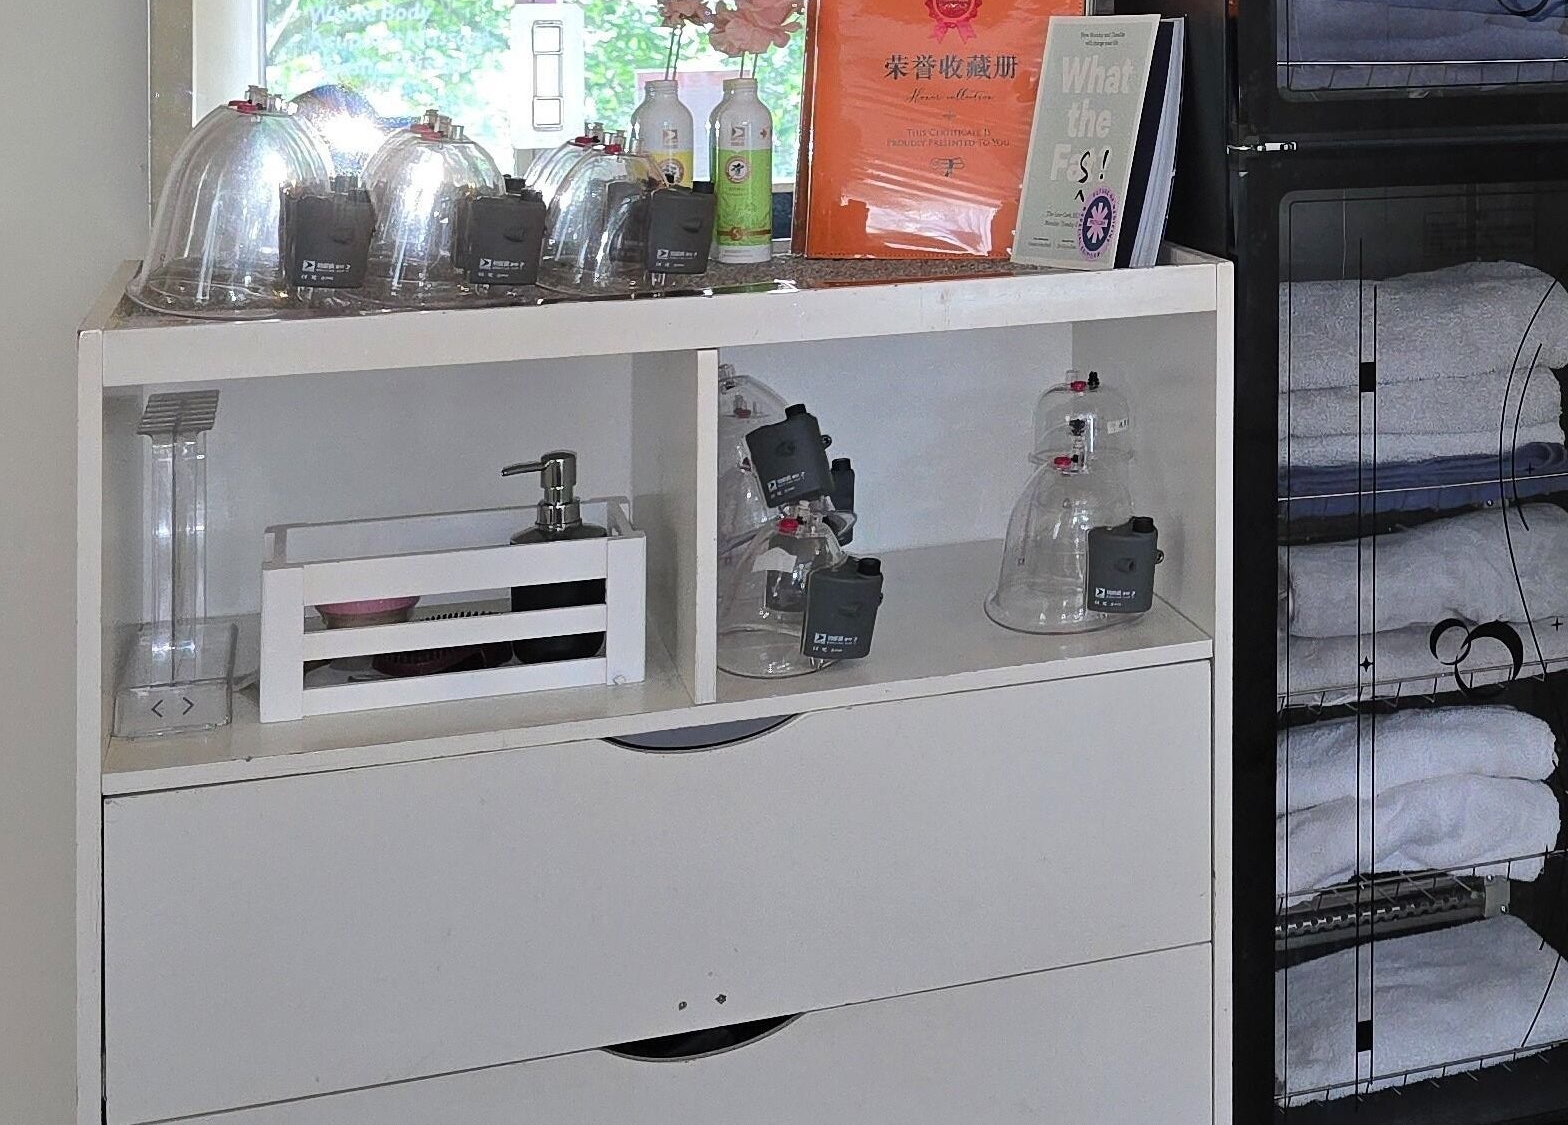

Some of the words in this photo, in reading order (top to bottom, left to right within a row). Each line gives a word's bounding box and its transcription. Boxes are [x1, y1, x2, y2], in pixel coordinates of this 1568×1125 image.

[884, 54, 1018, 81] 荣誉收藏册
[1062, 55, 1134, 94] What
[1068, 98, 1112, 138] the
